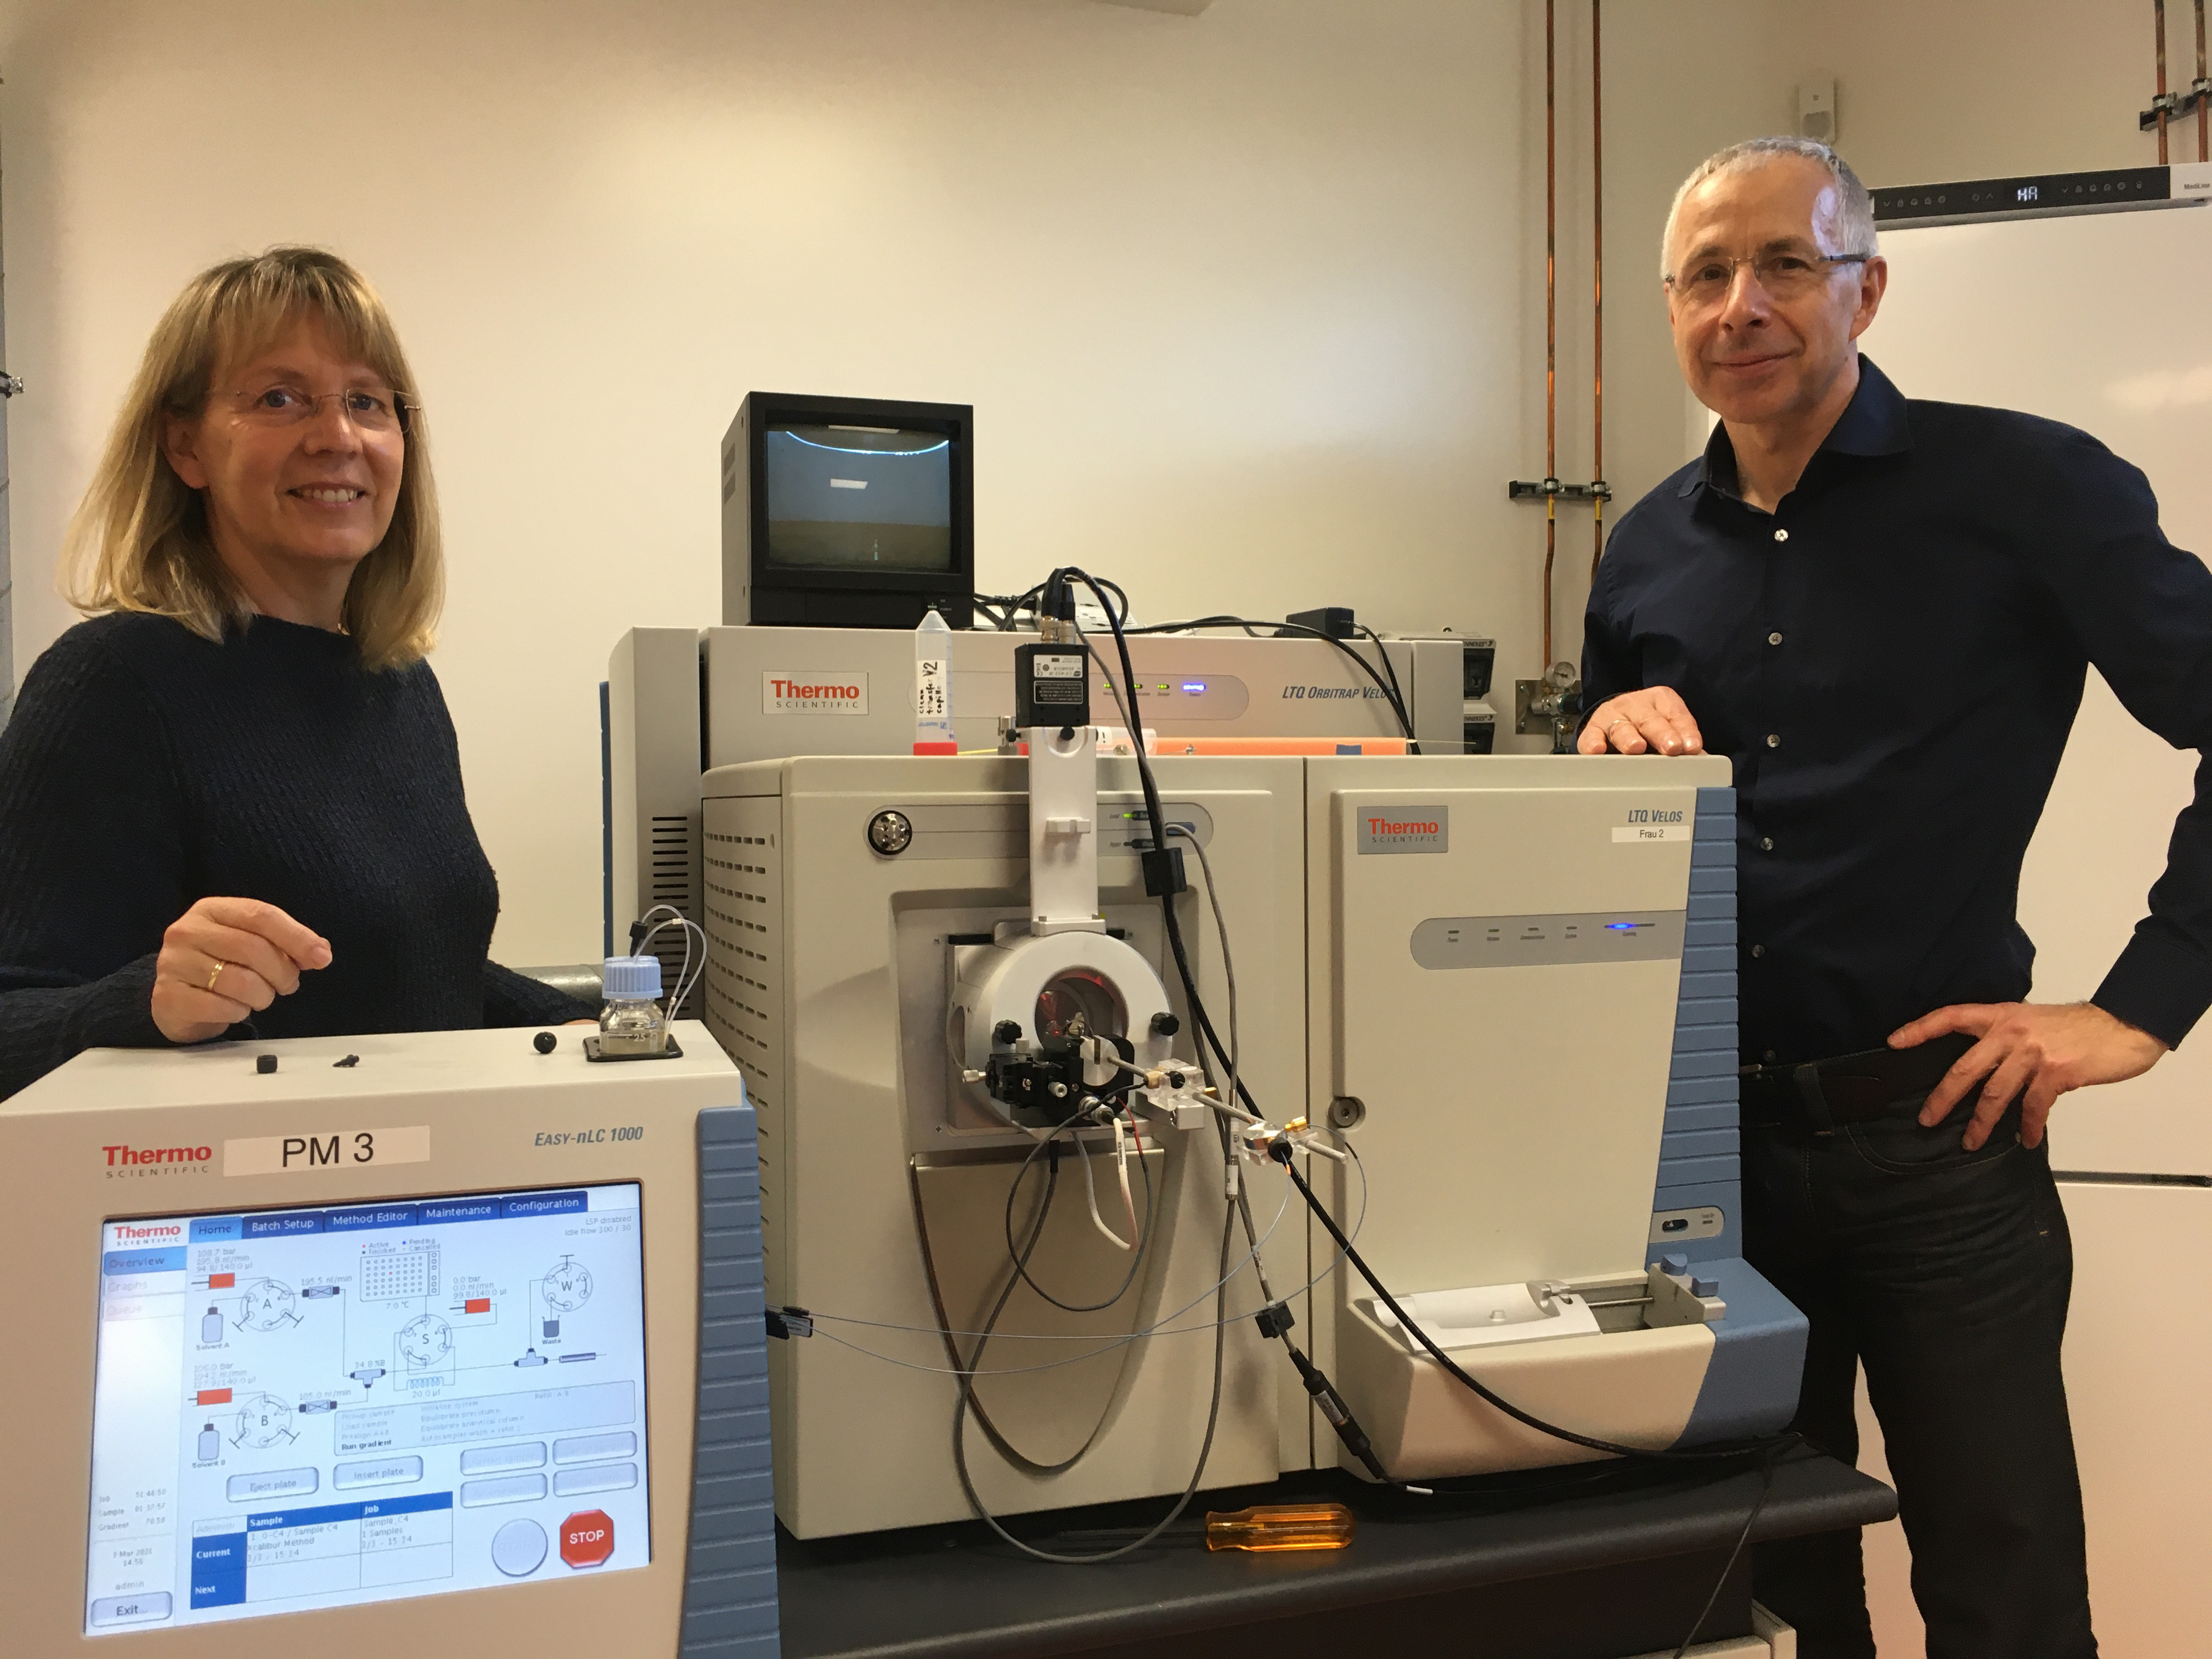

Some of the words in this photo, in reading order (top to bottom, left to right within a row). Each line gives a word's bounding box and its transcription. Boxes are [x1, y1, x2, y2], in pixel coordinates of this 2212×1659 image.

[922, 661, 938, 678] V2
[771, 680, 860, 699] Thermo
[1282, 686, 1305, 698] LTQ
[1628, 810, 1648, 822] LTQ
[1652, 810, 1683, 822] VELOS
[1368, 818, 1438, 834] Thermo
[1640, 830, 1657, 838] Frau
[1659, 829, 1664, 838] 2
[634, 1033, 646, 1042] 25
[610, 1126, 644, 1141] 1000
[283, 1136, 340, 1167] PM
[354, 1132, 374, 1163] 3
[102, 1146, 211, 1166] Thermo
[106, 1166, 208, 1179] SCIENTIFIC
[199, 1225, 232, 1235] Home
[252, 1221, 280, 1232] Batch
[284, 1219, 314, 1231] Setup
[333, 1213, 373, 1225] Method
[377, 1211, 408, 1223] Editor
[426, 1205, 491, 1218] Maintenance
[509, 1198, 579, 1212] Configuration
[600, 1215, 632, 1224] disabled
[114, 1225, 181, 1239] Thermo
[117, 1237, 179, 1246] SCIENTIFIC
[110, 1257, 165, 1269] Overview
[108, 1280, 147, 1292] Graphs
[561, 1281, 573, 1291] W
[263, 1299, 272, 1310] A
[422, 1334, 430, 1345] S
[261, 1415, 269, 1426] B
[359, 1440, 392, 1450] gradient
[354, 1471, 379, 1480] Insert
[382, 1468, 404, 1478] plate
[250, 1482, 272, 1493] Eject
[275, 1480, 297, 1490] plate
[250, 1516, 283, 1527] Sample
[364, 1505, 379, 1515] Job
[284, 1537, 315, 1547] Method
[569, 1530, 604, 1544] STOP
[196, 1548, 231, 1559] Current
[115, 1581, 144, 1590] admin
[195, 1585, 217, 1595] Next
